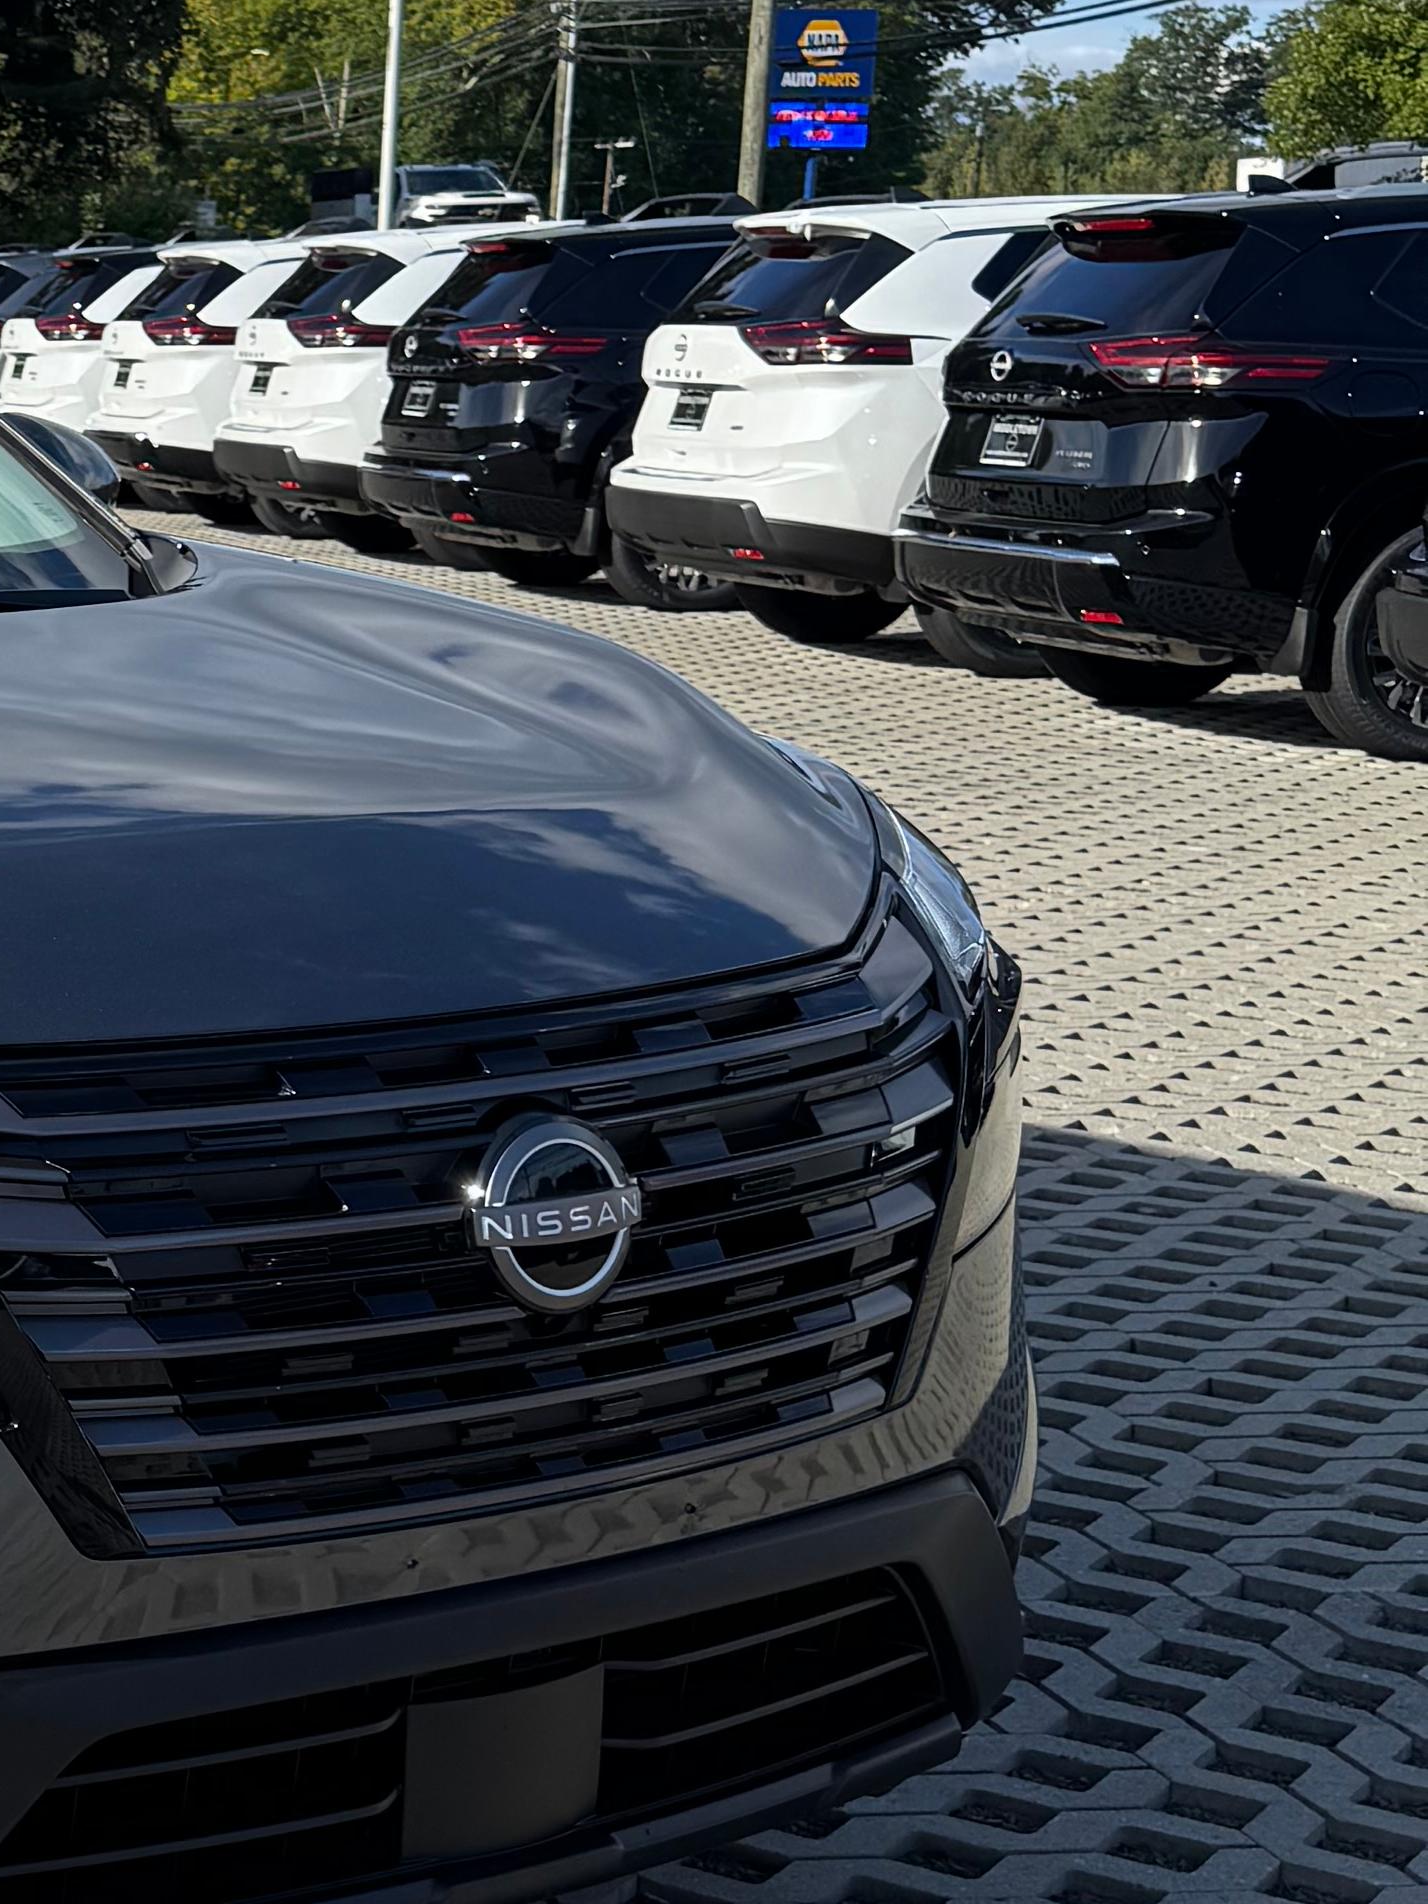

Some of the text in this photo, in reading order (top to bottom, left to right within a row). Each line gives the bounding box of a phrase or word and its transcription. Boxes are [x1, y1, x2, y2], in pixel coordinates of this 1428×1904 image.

[780, 71, 861, 87] AUTO PARTS
[481, 1194, 640, 1241] NISSAN
